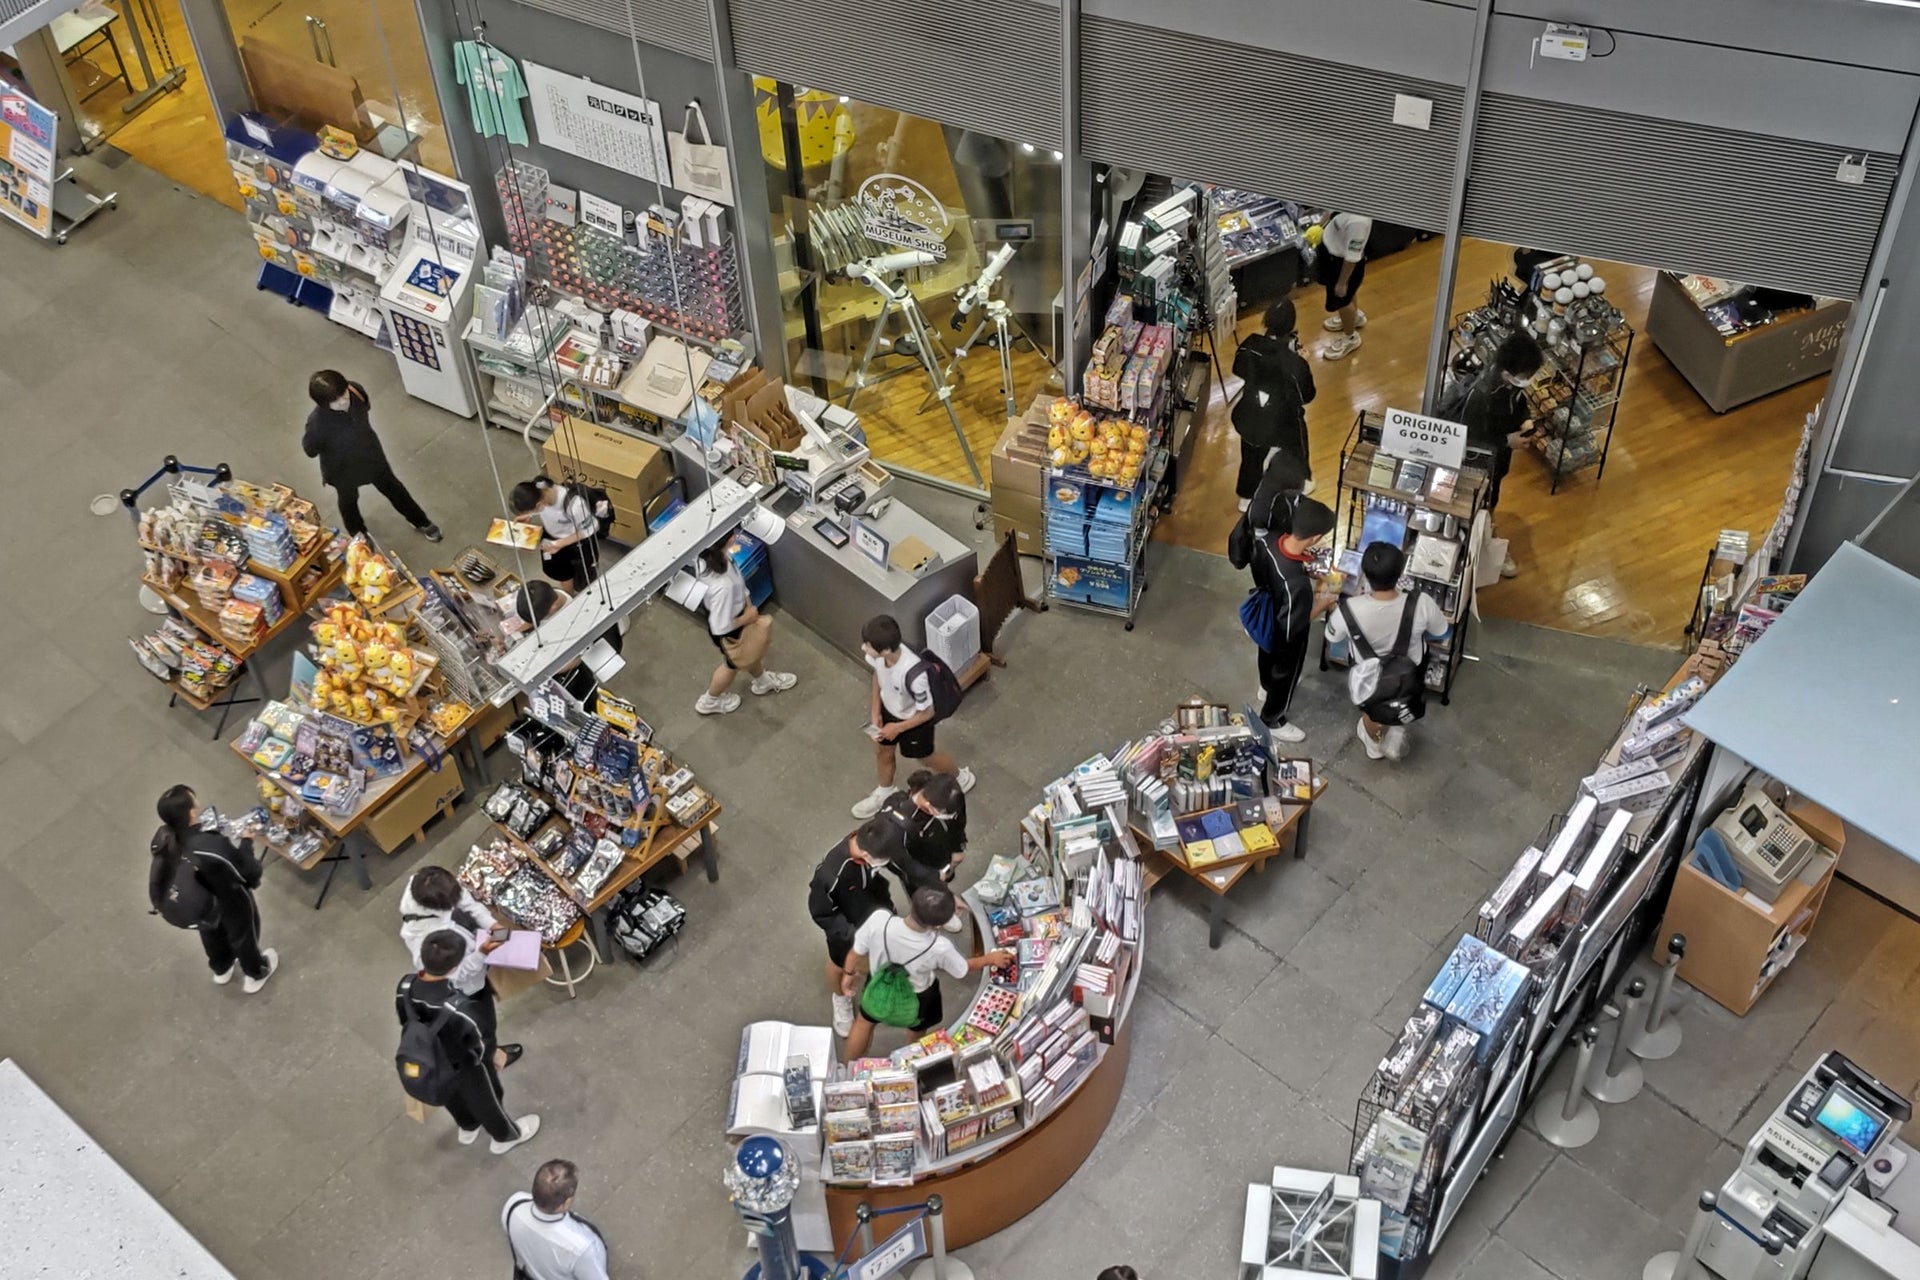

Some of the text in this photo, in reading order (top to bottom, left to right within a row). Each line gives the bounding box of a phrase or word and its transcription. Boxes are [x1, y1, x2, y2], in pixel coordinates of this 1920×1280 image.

[865, 225, 913, 245] MUSEUM
[914, 238, 946, 254] SHOP
[1392, 414, 1461, 438] ORIGINAL
[1399, 429, 1448, 446] GOODS
